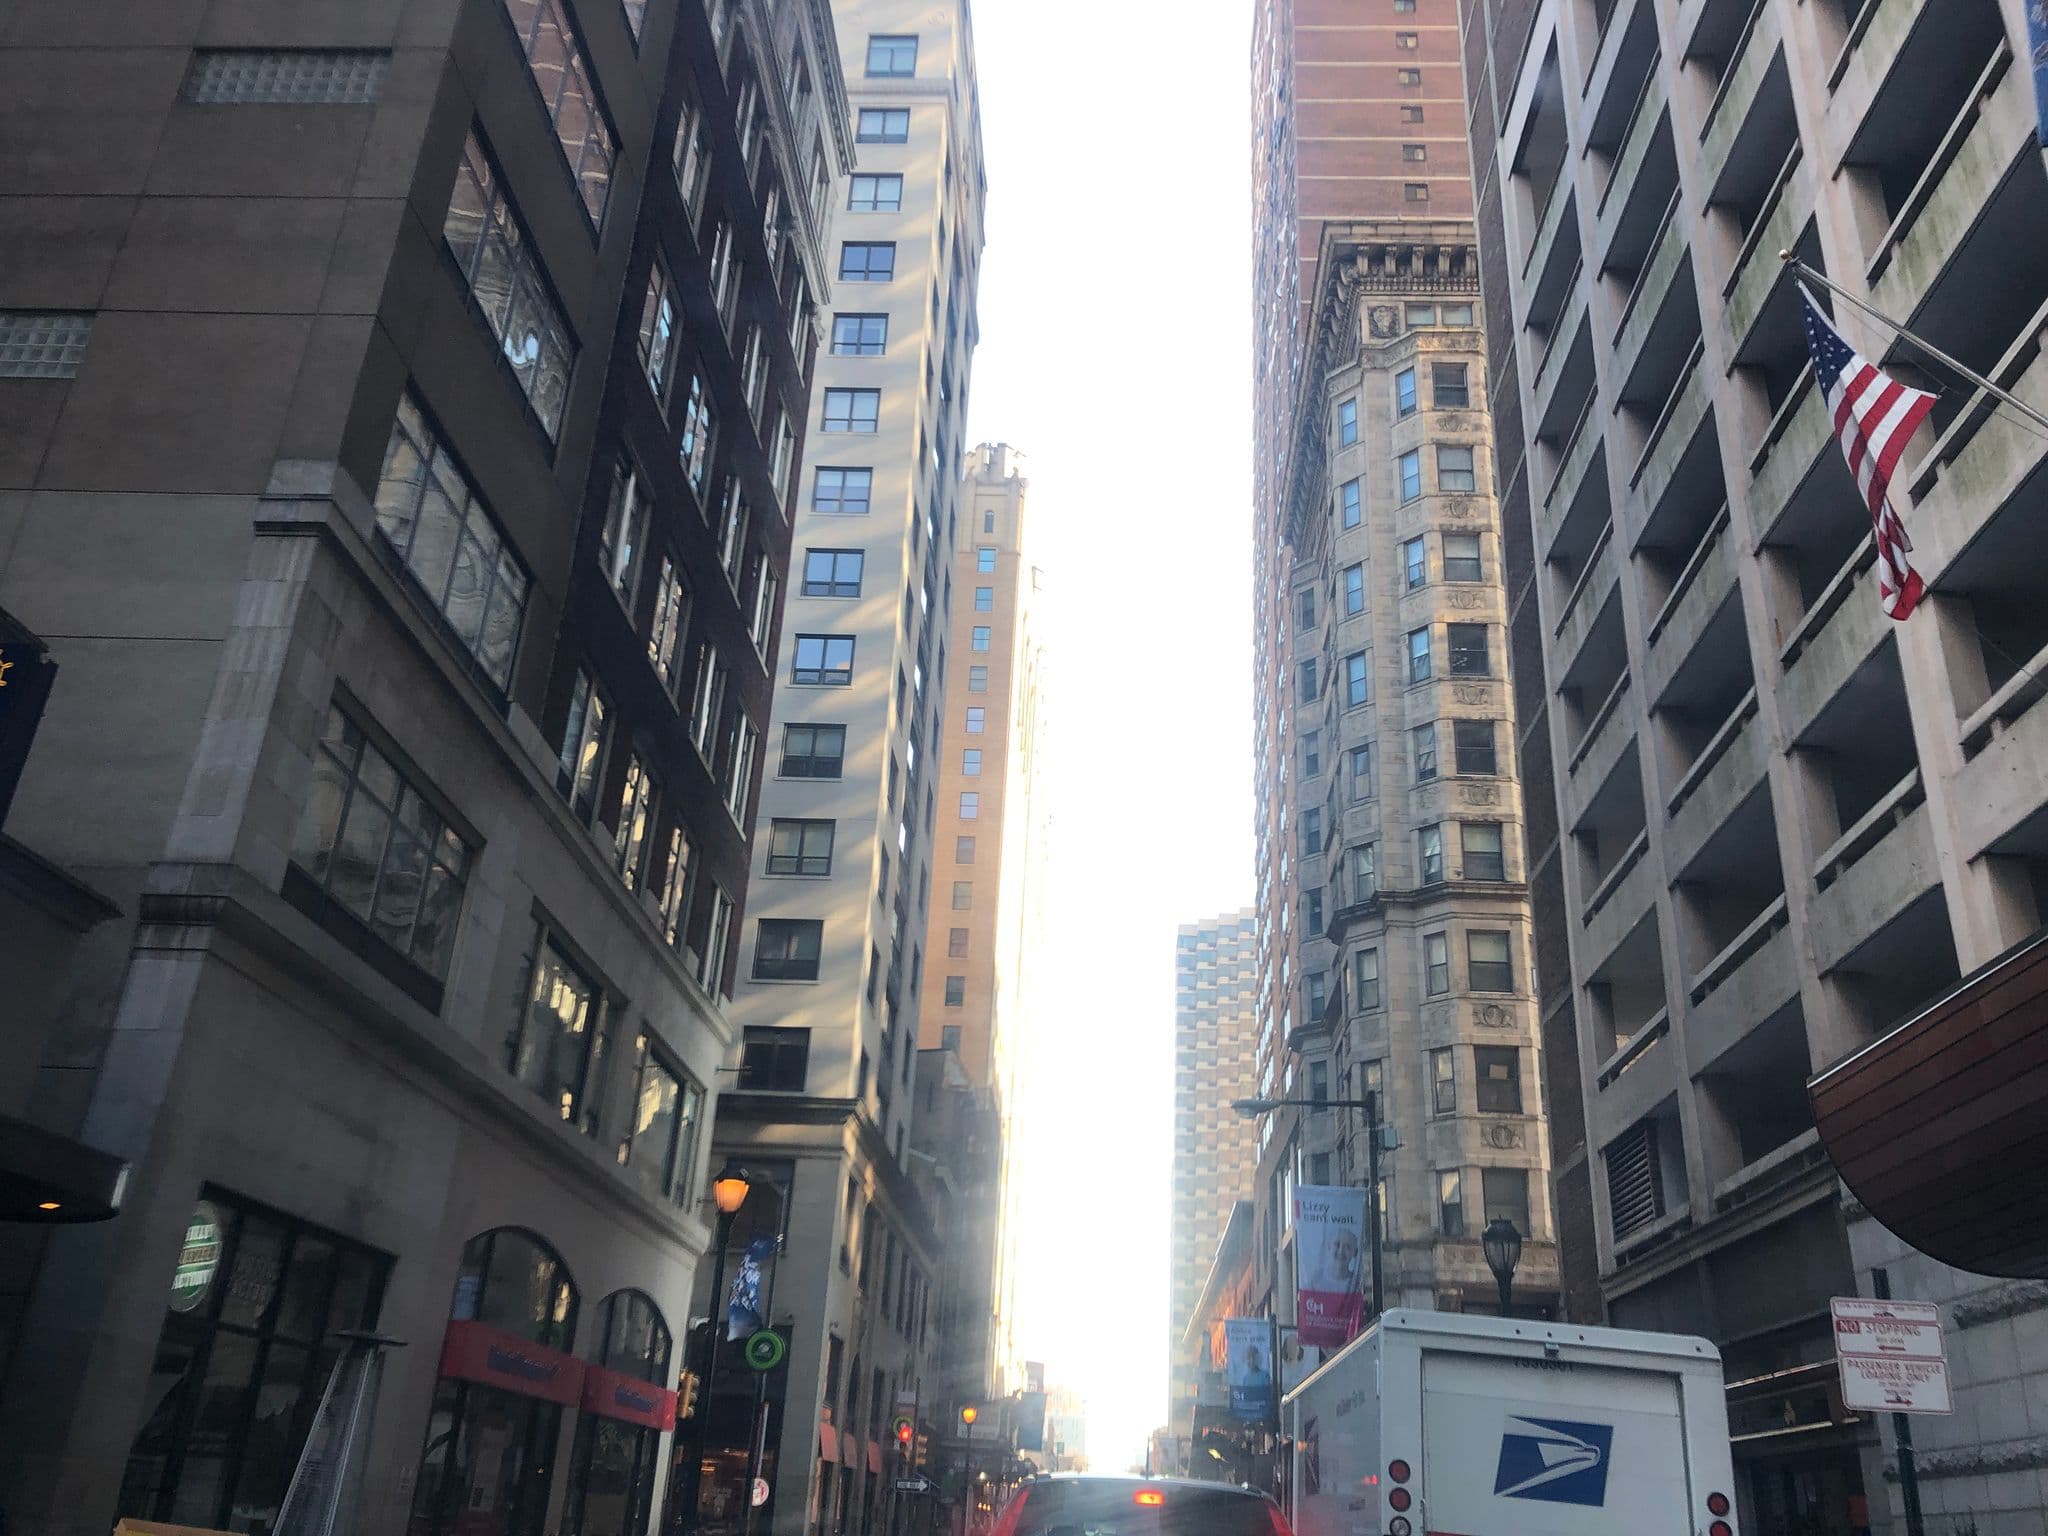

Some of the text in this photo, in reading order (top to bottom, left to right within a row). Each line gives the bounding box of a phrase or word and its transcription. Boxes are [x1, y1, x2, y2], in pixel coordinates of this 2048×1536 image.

[1302, 1200, 1330, 1214] Lizzy
[1839, 1320, 1921, 1337] NO STOPPING
